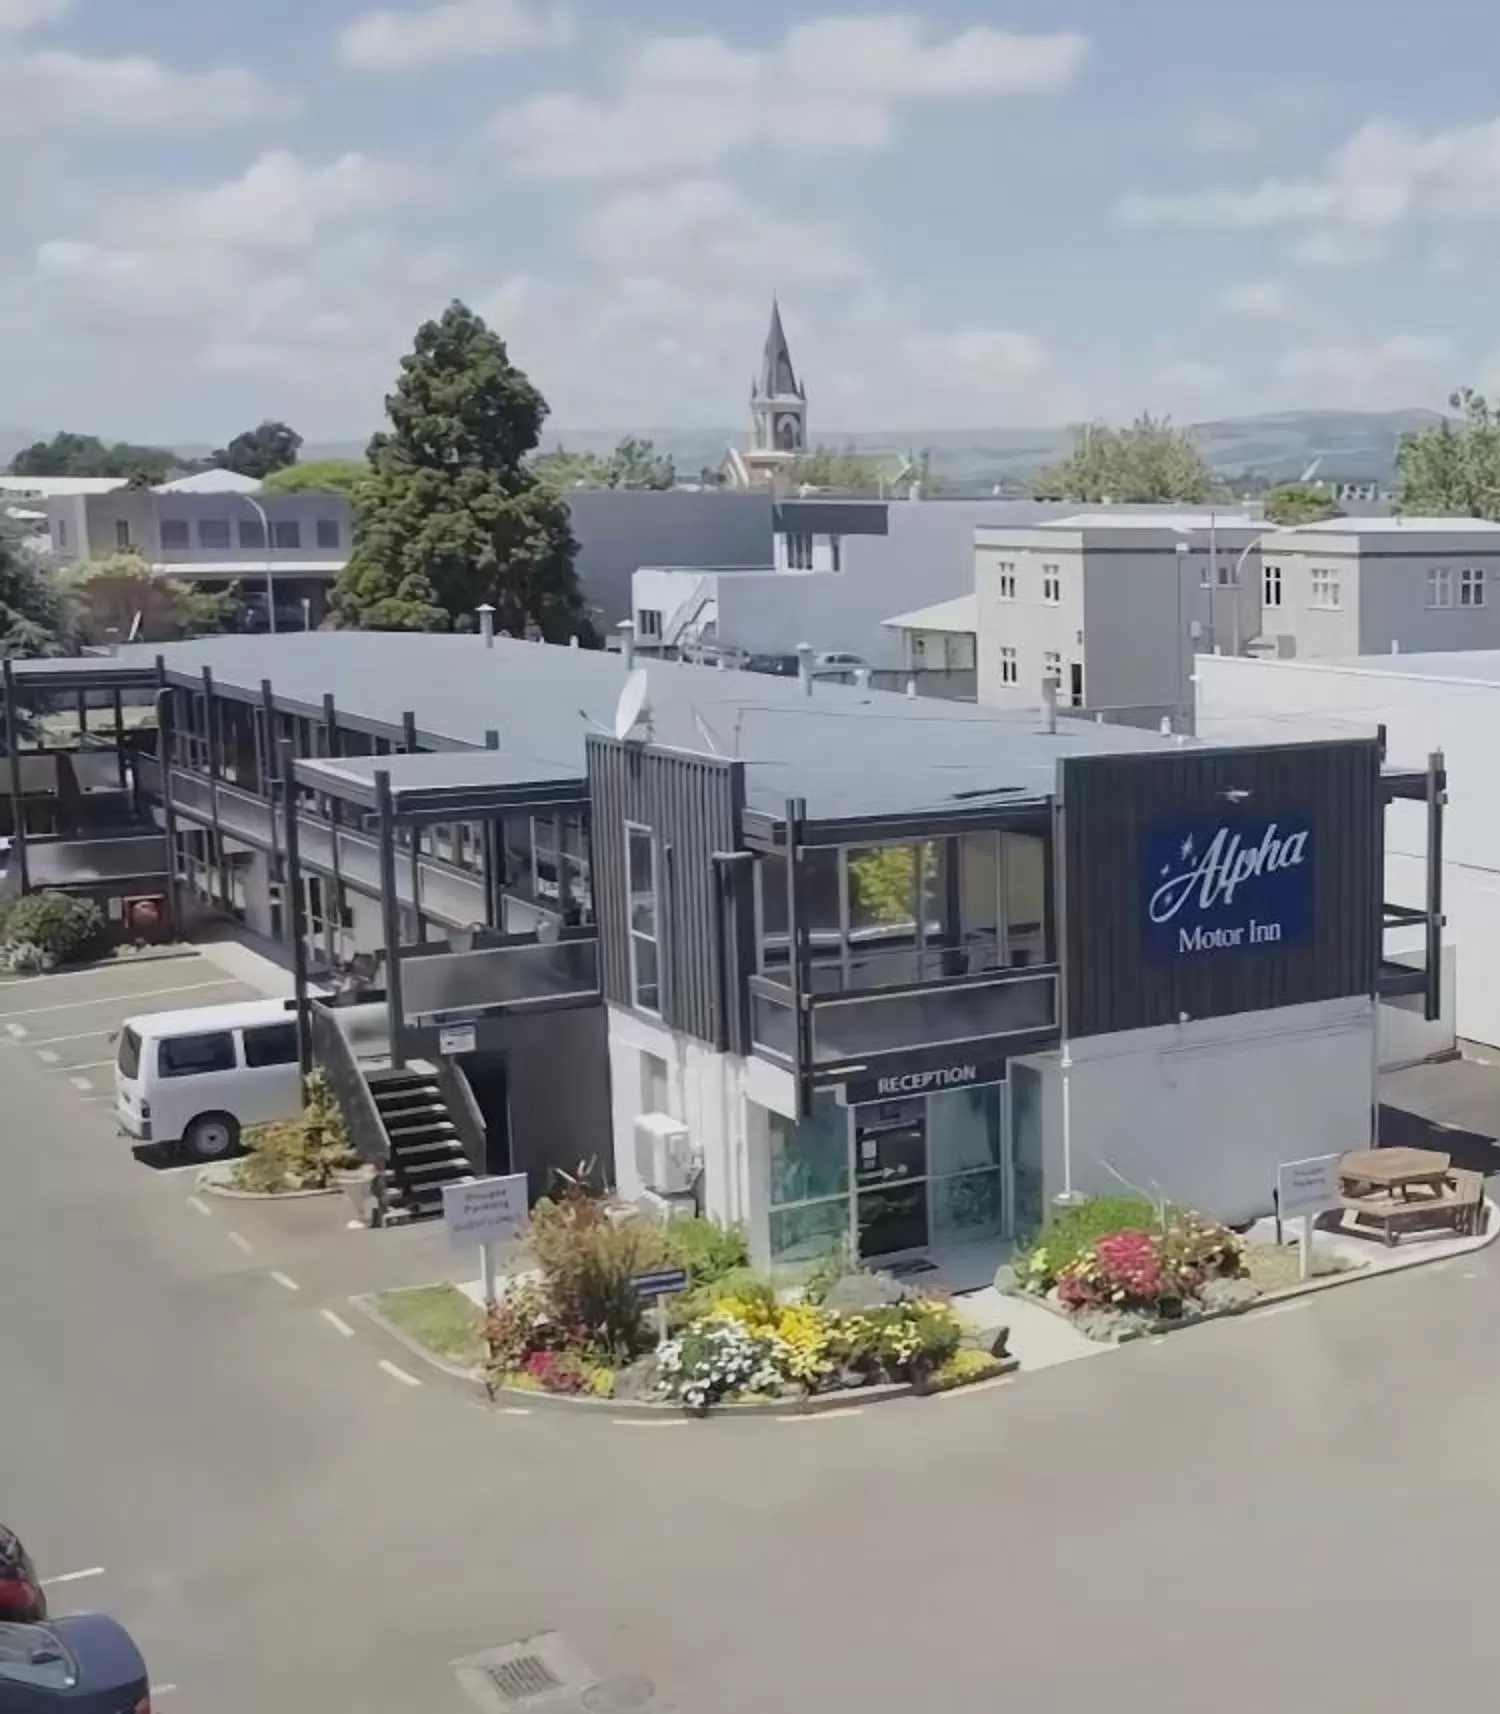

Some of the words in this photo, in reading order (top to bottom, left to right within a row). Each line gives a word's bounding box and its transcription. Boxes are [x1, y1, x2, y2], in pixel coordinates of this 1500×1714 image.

[1149, 823, 1309, 923] Alpha
[1179, 926, 1244, 952] Motor
[1250, 919, 1281, 943] Inn
[877, 1065, 977, 1094] RECEPTION
